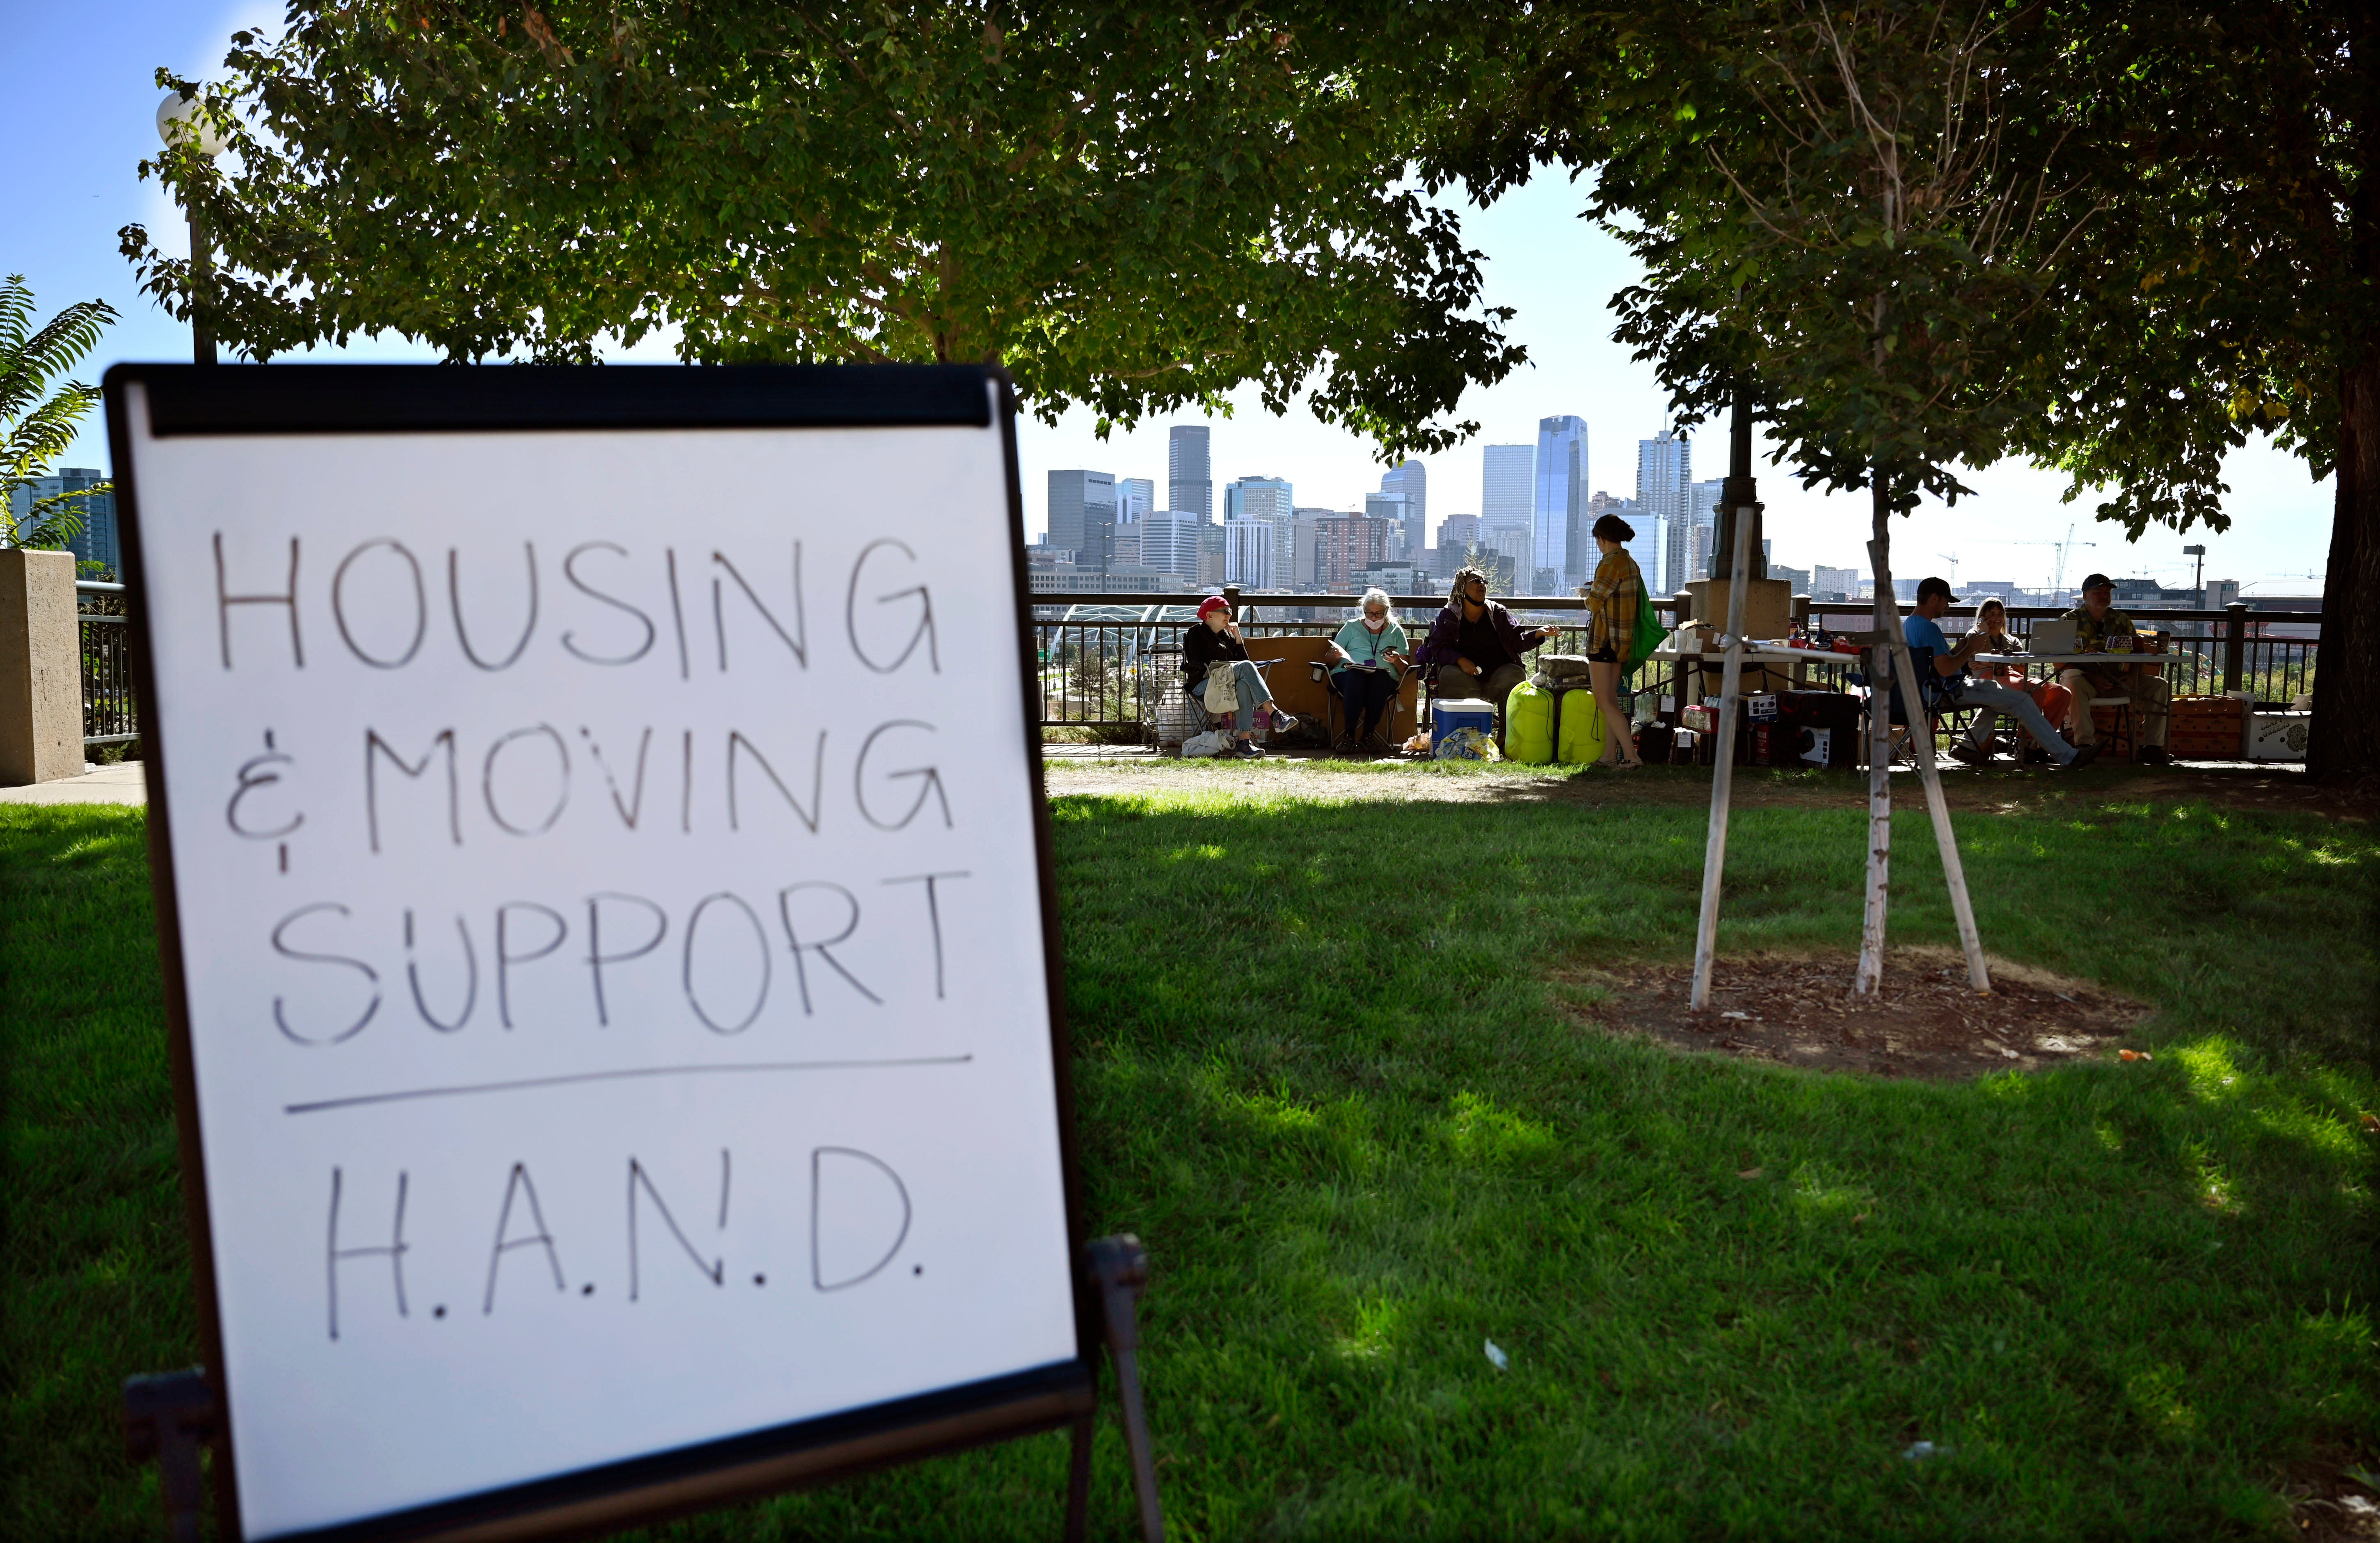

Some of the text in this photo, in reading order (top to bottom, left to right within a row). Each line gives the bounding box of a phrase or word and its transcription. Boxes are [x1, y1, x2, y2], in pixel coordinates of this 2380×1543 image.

[211, 528, 942, 681] HOUSING
[224, 719, 955, 875] & MOVING
[269, 873, 974, 1046] SUPPORT
[326, 1145, 925, 1343] H.A.N.D.
